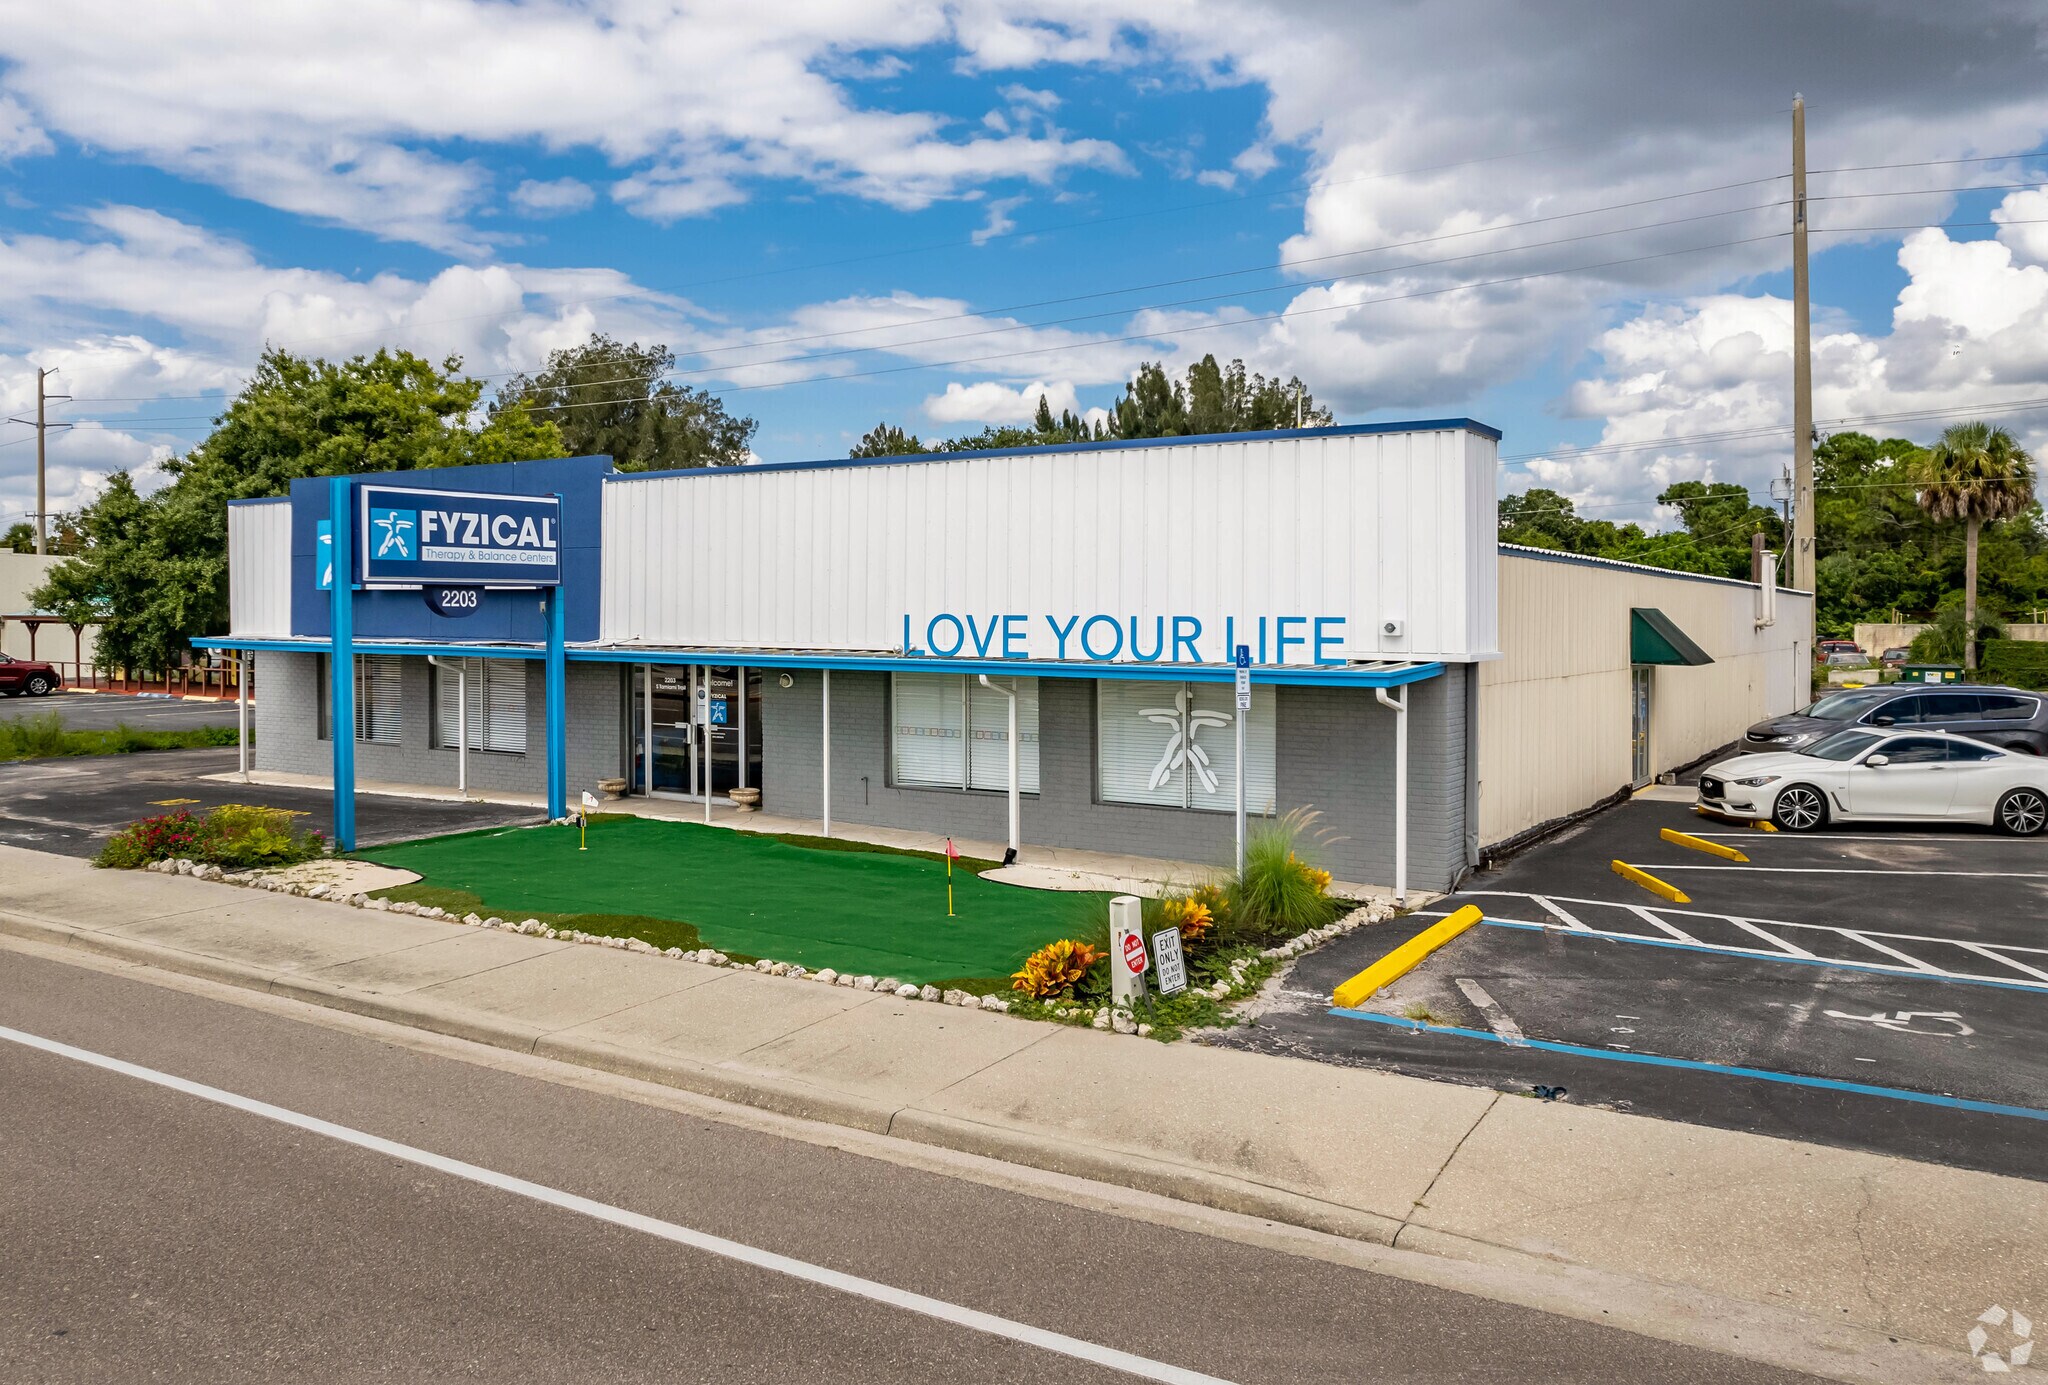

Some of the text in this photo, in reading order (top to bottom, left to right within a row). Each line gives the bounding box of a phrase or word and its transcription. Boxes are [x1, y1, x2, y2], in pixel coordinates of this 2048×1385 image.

[426, 548, 554, 563] Therapy & Balance Centers
[442, 590, 477, 607] 2203
[904, 614, 1347, 666] LOVE YOUR LIFE
[1125, 943, 1131, 952] DO
[1160, 936, 1175, 951] EXIT
[1131, 957, 1143, 968] ENTER
[1160, 949, 1179, 965] ONLY
[1162, 963, 1181, 976] DO NOT
[1165, 974, 1181, 985] ENTER
